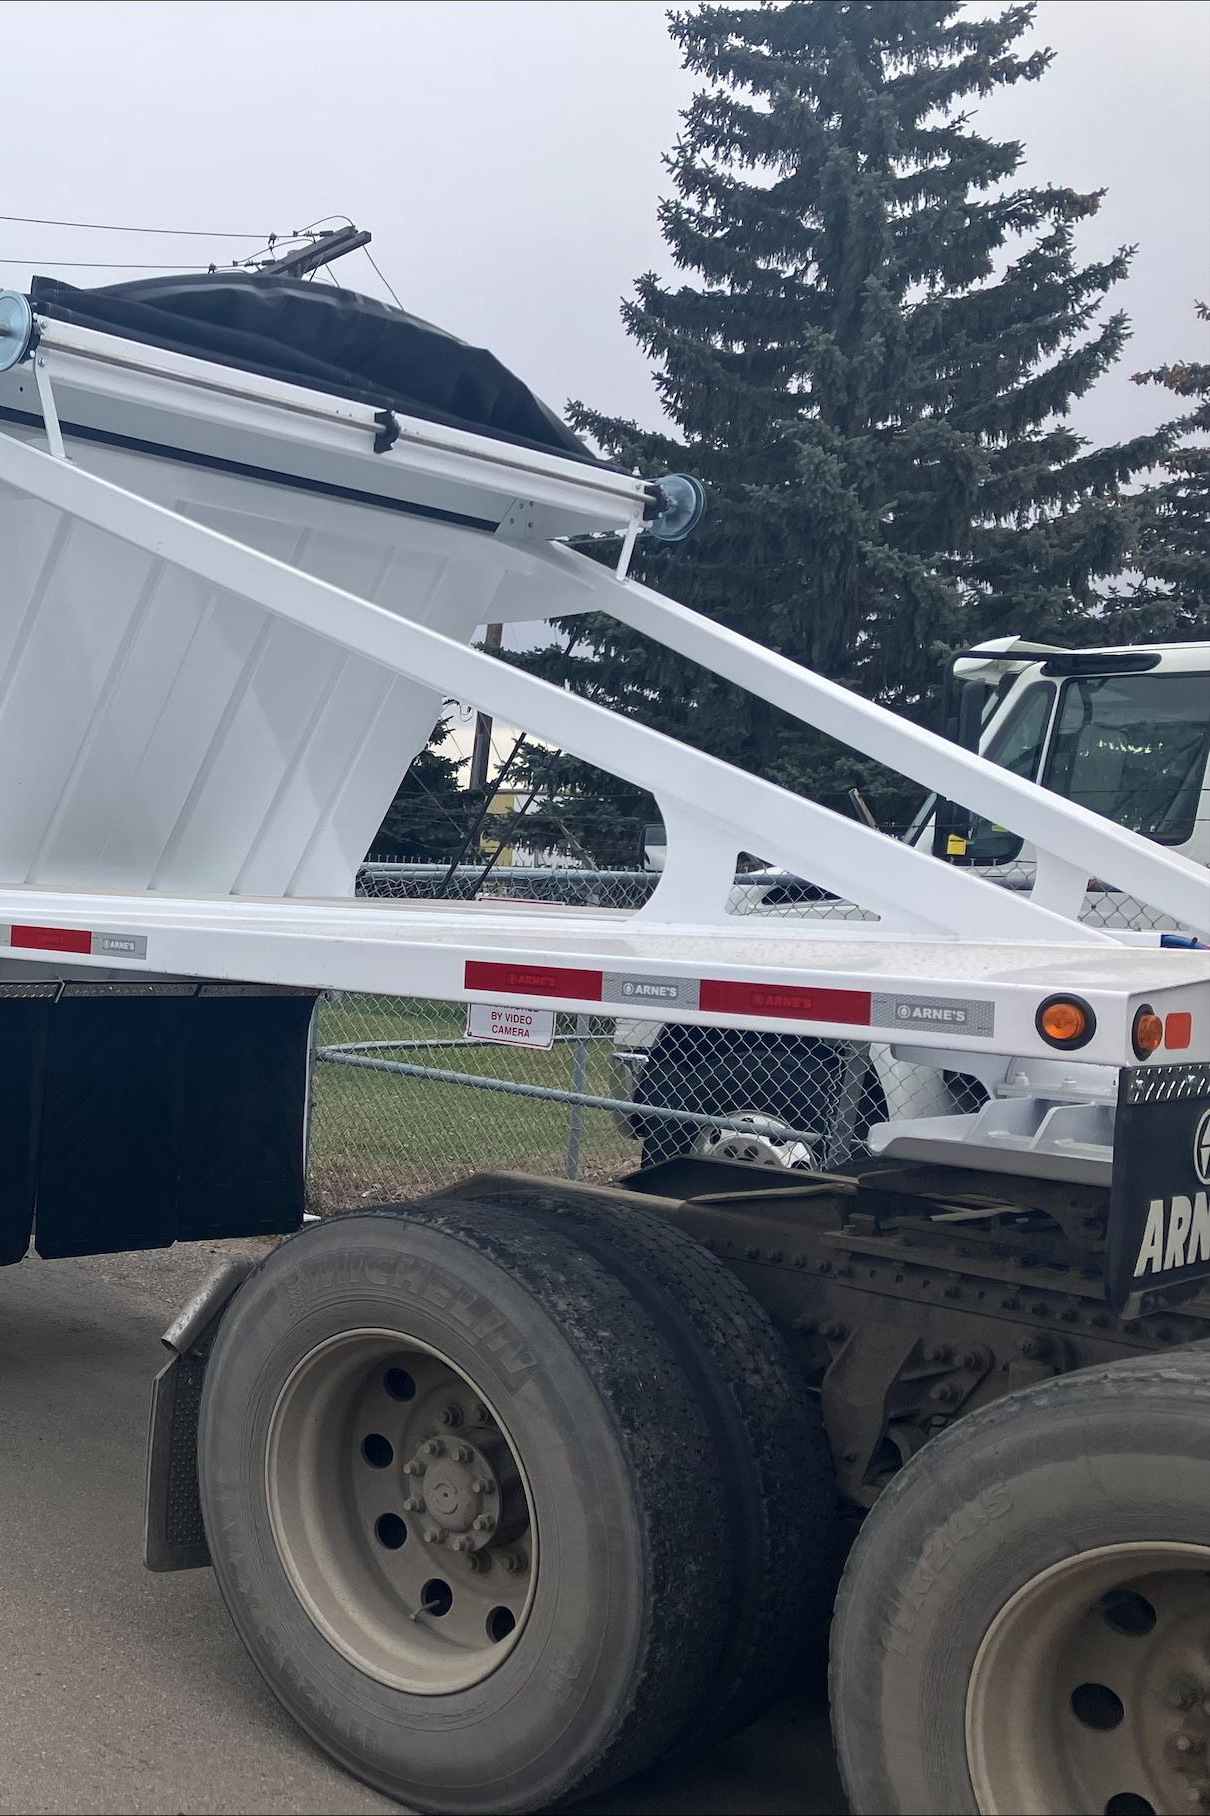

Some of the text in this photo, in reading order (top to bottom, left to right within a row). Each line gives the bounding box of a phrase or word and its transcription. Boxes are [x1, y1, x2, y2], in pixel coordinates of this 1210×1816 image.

[109, 940, 135, 951] ARNE'S
[518, 976, 556, 987] ARNE'S
[634, 984, 678, 997] ARNE'S
[765, 994, 812, 1009] ARNE'S
[491, 1011, 533, 1025] BY VIDEO
[912, 1007, 966, 1022] ARNE'S
[491, 1024, 530, 1038] CAMERA
